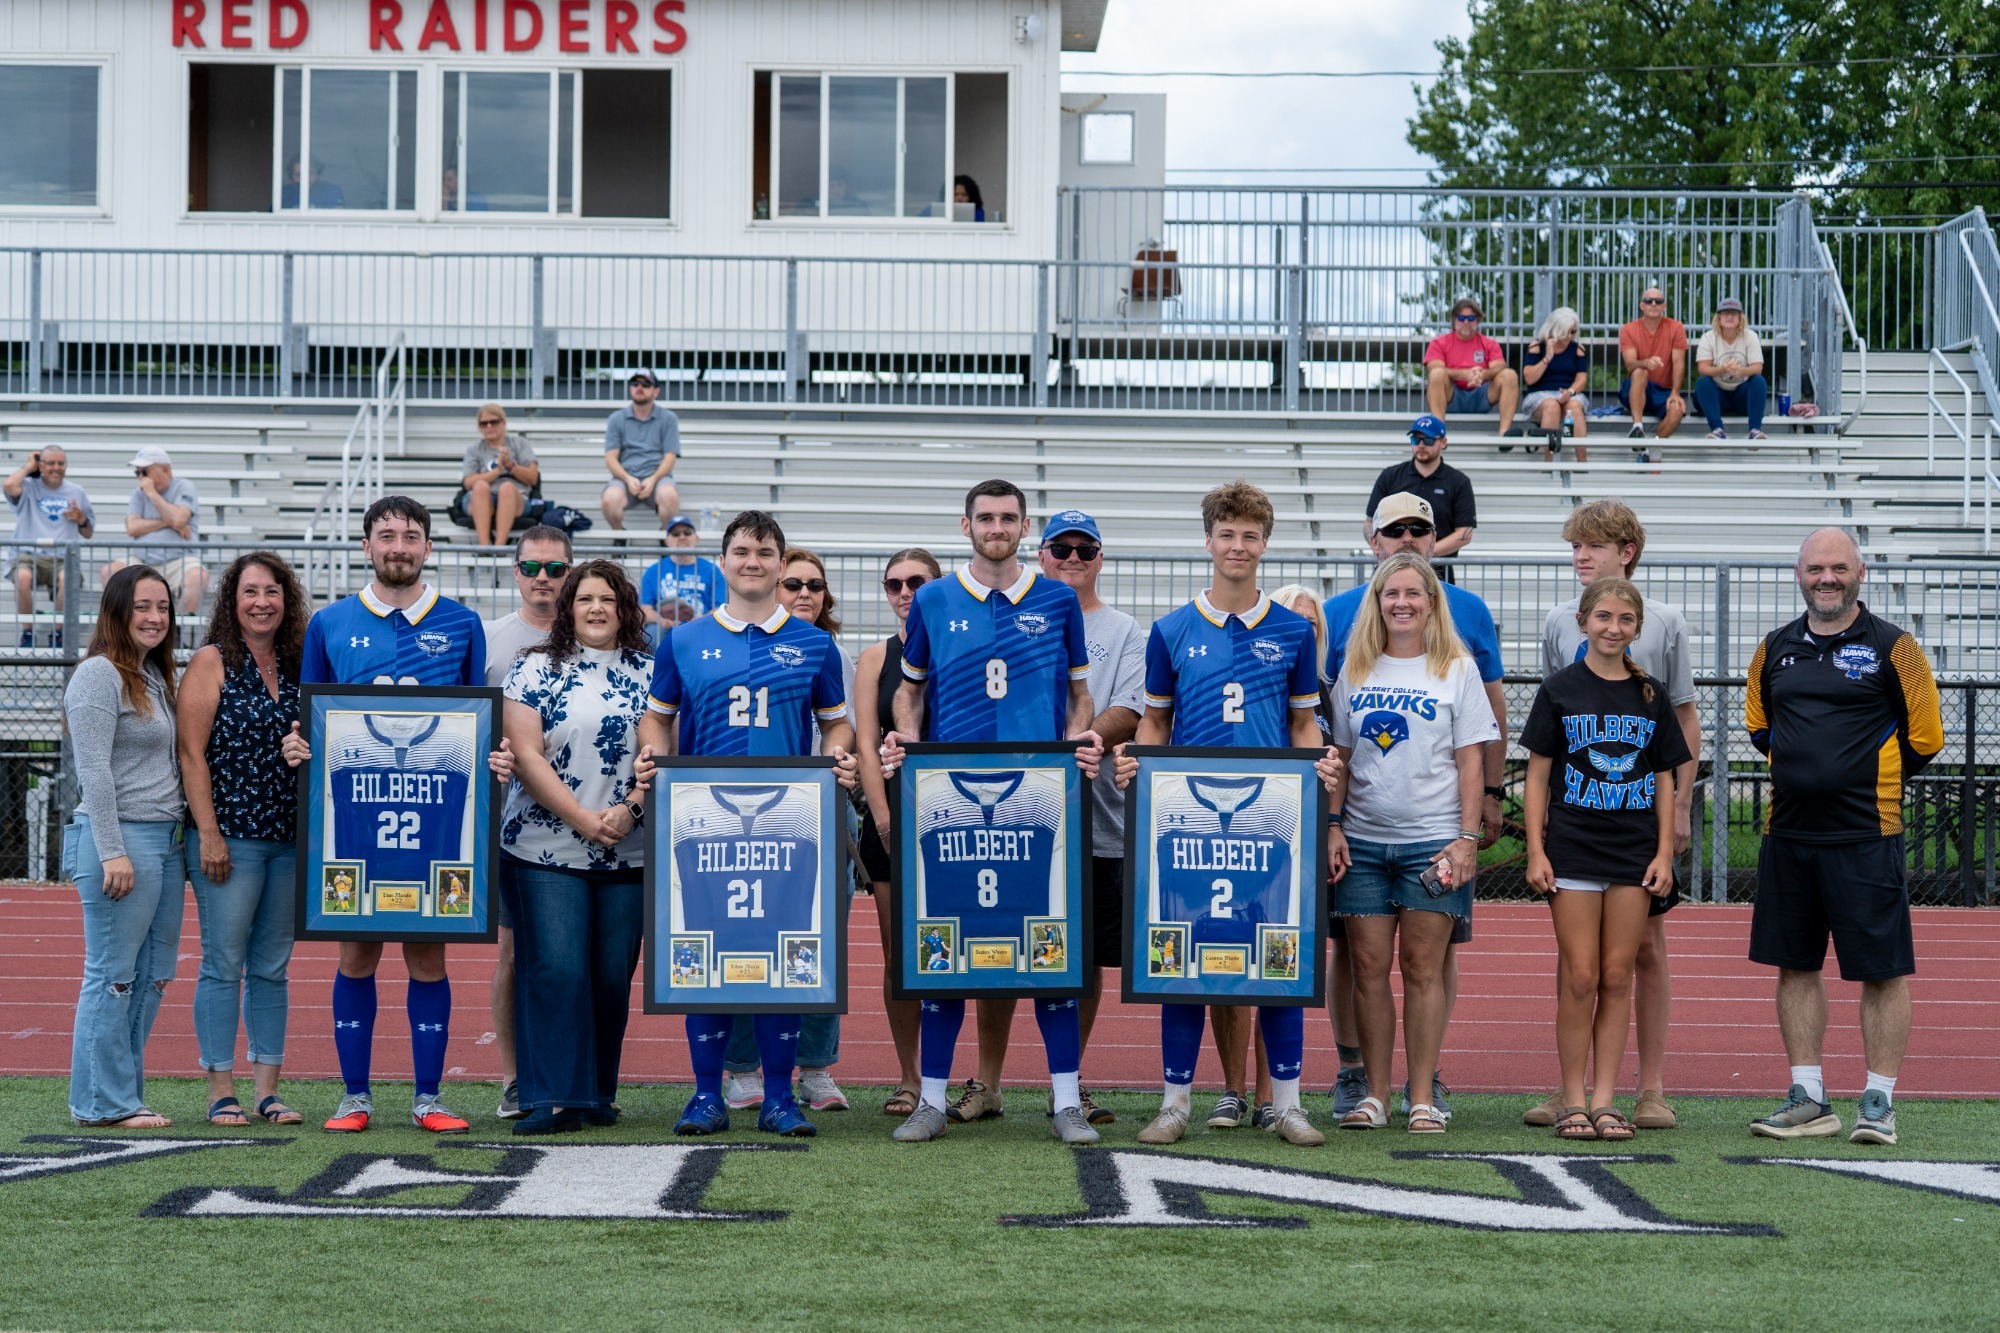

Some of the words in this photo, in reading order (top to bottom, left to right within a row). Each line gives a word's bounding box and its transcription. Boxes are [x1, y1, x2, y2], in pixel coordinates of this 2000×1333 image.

[172, 0, 309, 48] RED
[369, 0, 687, 53] RAIDERS
[1019, 615, 1045, 624] HAWKS
[420, 633, 447, 643] HAWKS
[775, 646, 802, 656] HAWKS
[1255, 641, 1280, 652] HAWKS
[1840, 648, 1876, 661] HAWKS
[986, 659, 1008, 700] 8
[1392, 687, 1428, 696] COLLEGE
[728, 685, 770, 728] 21
[1222, 682, 1245, 723] 2
[1348, 693, 1439, 722] HAWKS
[351, 773, 447, 804] HILBERT
[1564, 763, 1656, 811] HAWKS
[377, 811, 421, 849] 22
[937, 829, 1034, 862] HILBERT
[697, 842, 796, 873] HILBERT
[1173, 837, 1274, 872] HILBERT
[727, 879, 765, 918] 21
[977, 868, 998, 908] 8
[1210, 878, 1233, 919] 2
